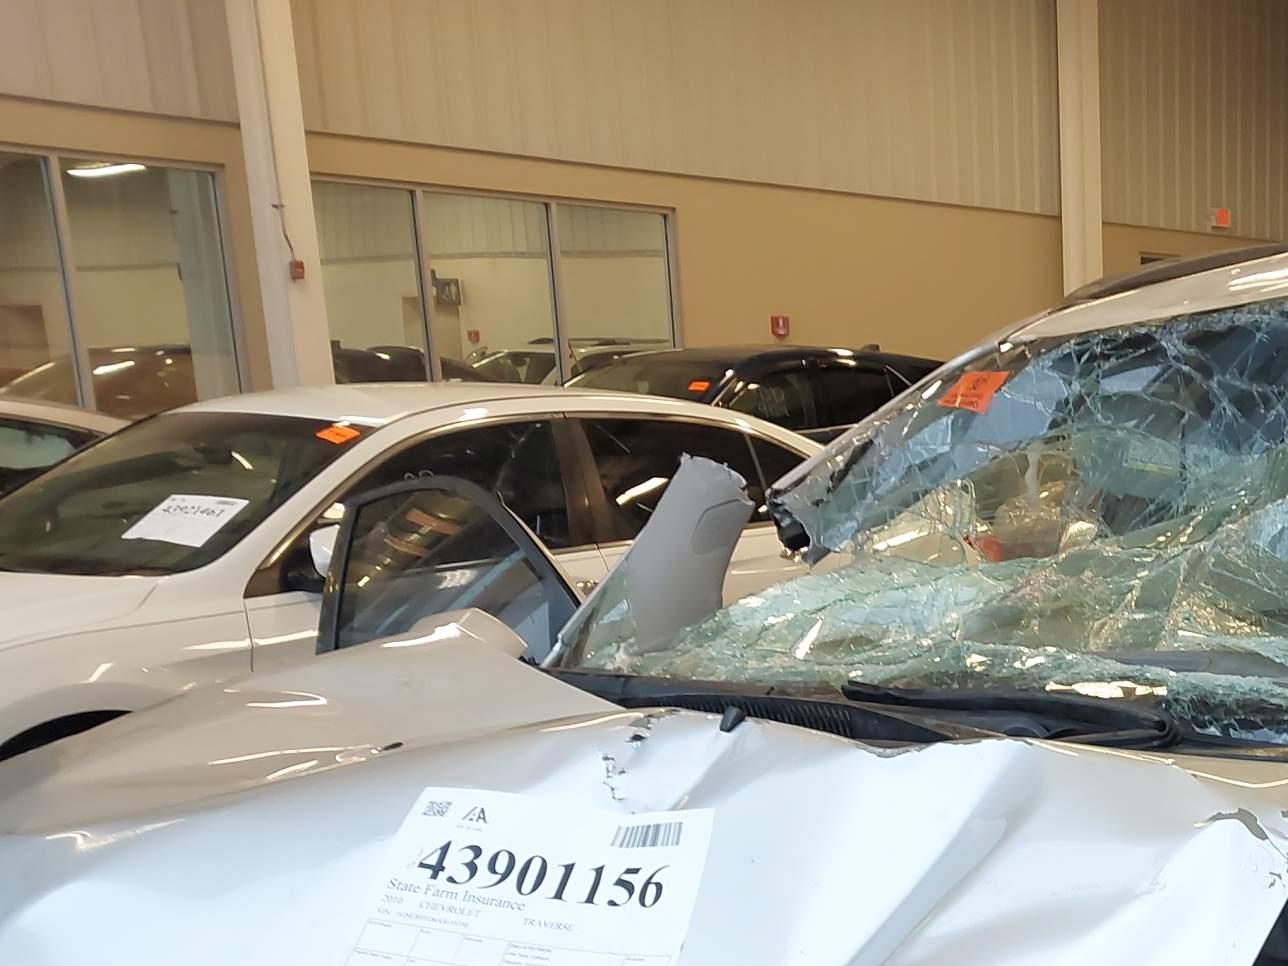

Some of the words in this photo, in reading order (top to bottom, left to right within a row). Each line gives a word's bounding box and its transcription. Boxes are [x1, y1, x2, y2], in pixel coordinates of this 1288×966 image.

[417, 840, 671, 908] 43901156
[387, 878, 421, 894] State
[424, 883, 459, 901] Farm
[463, 889, 527, 911] Insurance
[419, 901, 481, 918] CHEVROLET
[523, 917, 575, 932] TRAVERSE
